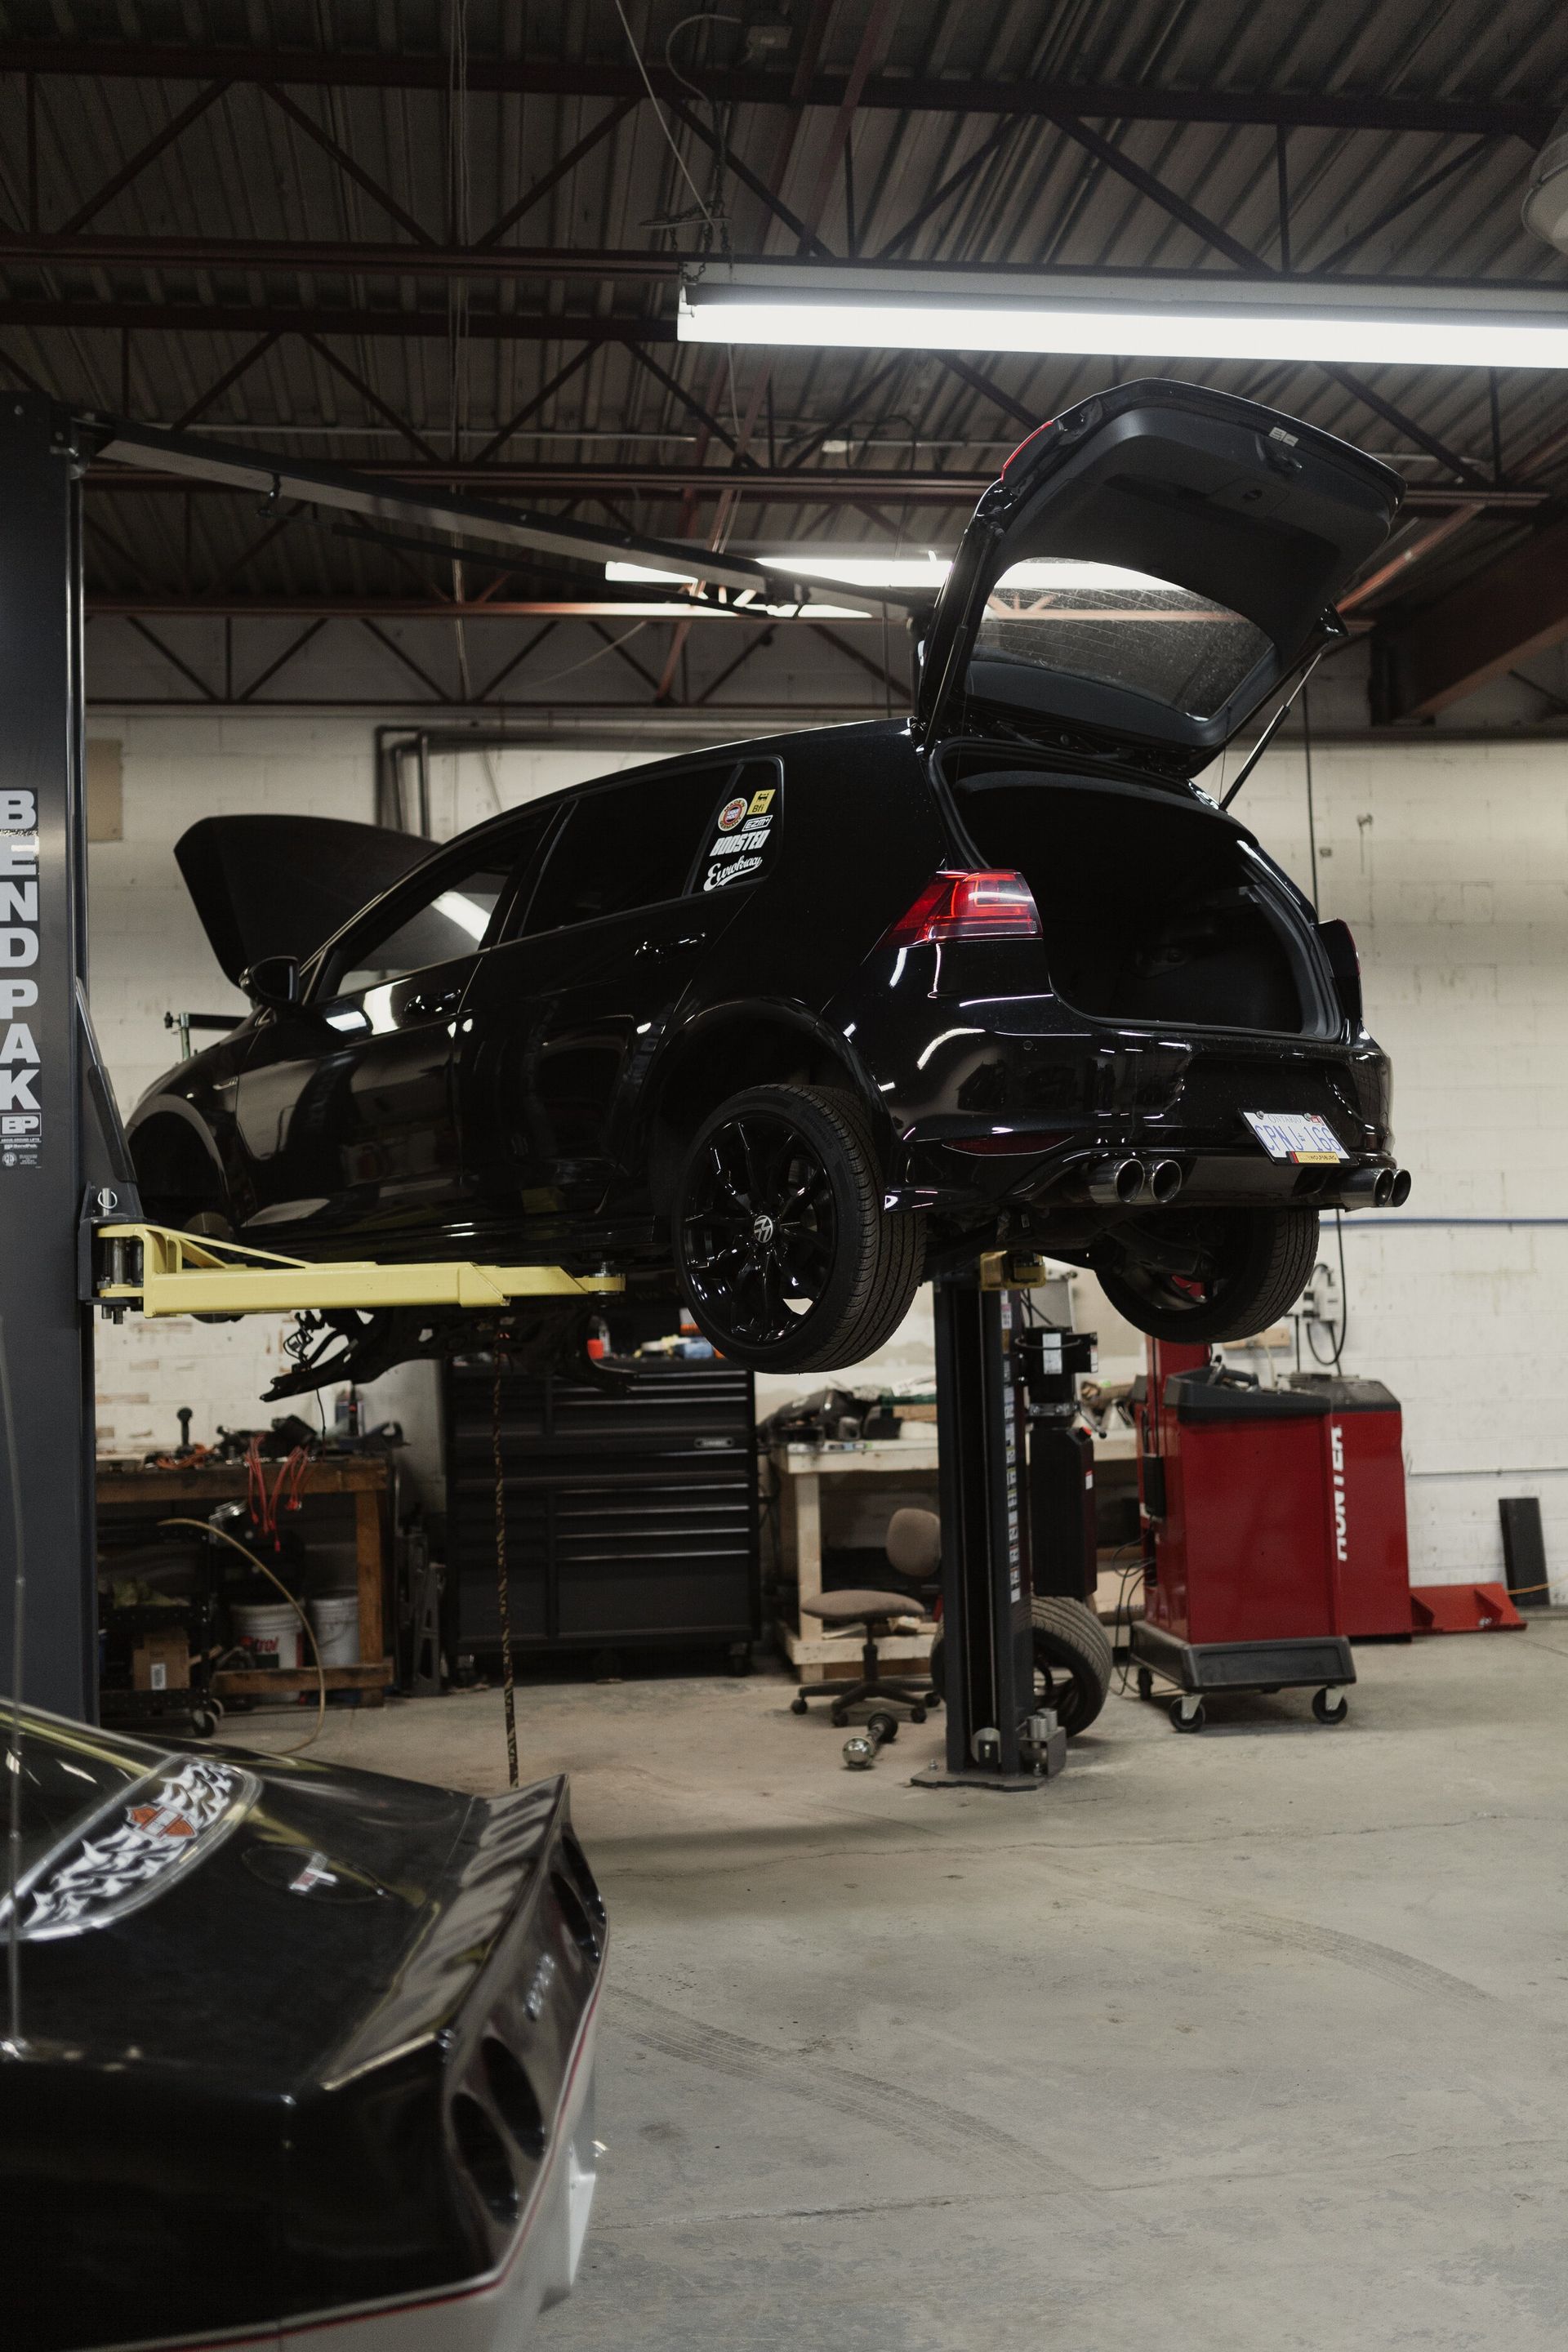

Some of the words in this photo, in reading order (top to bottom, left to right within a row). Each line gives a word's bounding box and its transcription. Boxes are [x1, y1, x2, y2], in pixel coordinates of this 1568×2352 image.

[751, 804, 764, 813] Bfi
[710, 829, 771, 857] BOOSTED
[0, 790, 41, 1111] BENDPAK
[2, 1116, 39, 1134] BP
[1267, 1115, 1302, 1124] ONTARIO
[1254, 1125, 1304, 1152] CPNJ
[1303, 1126, 1342, 1152] 166
